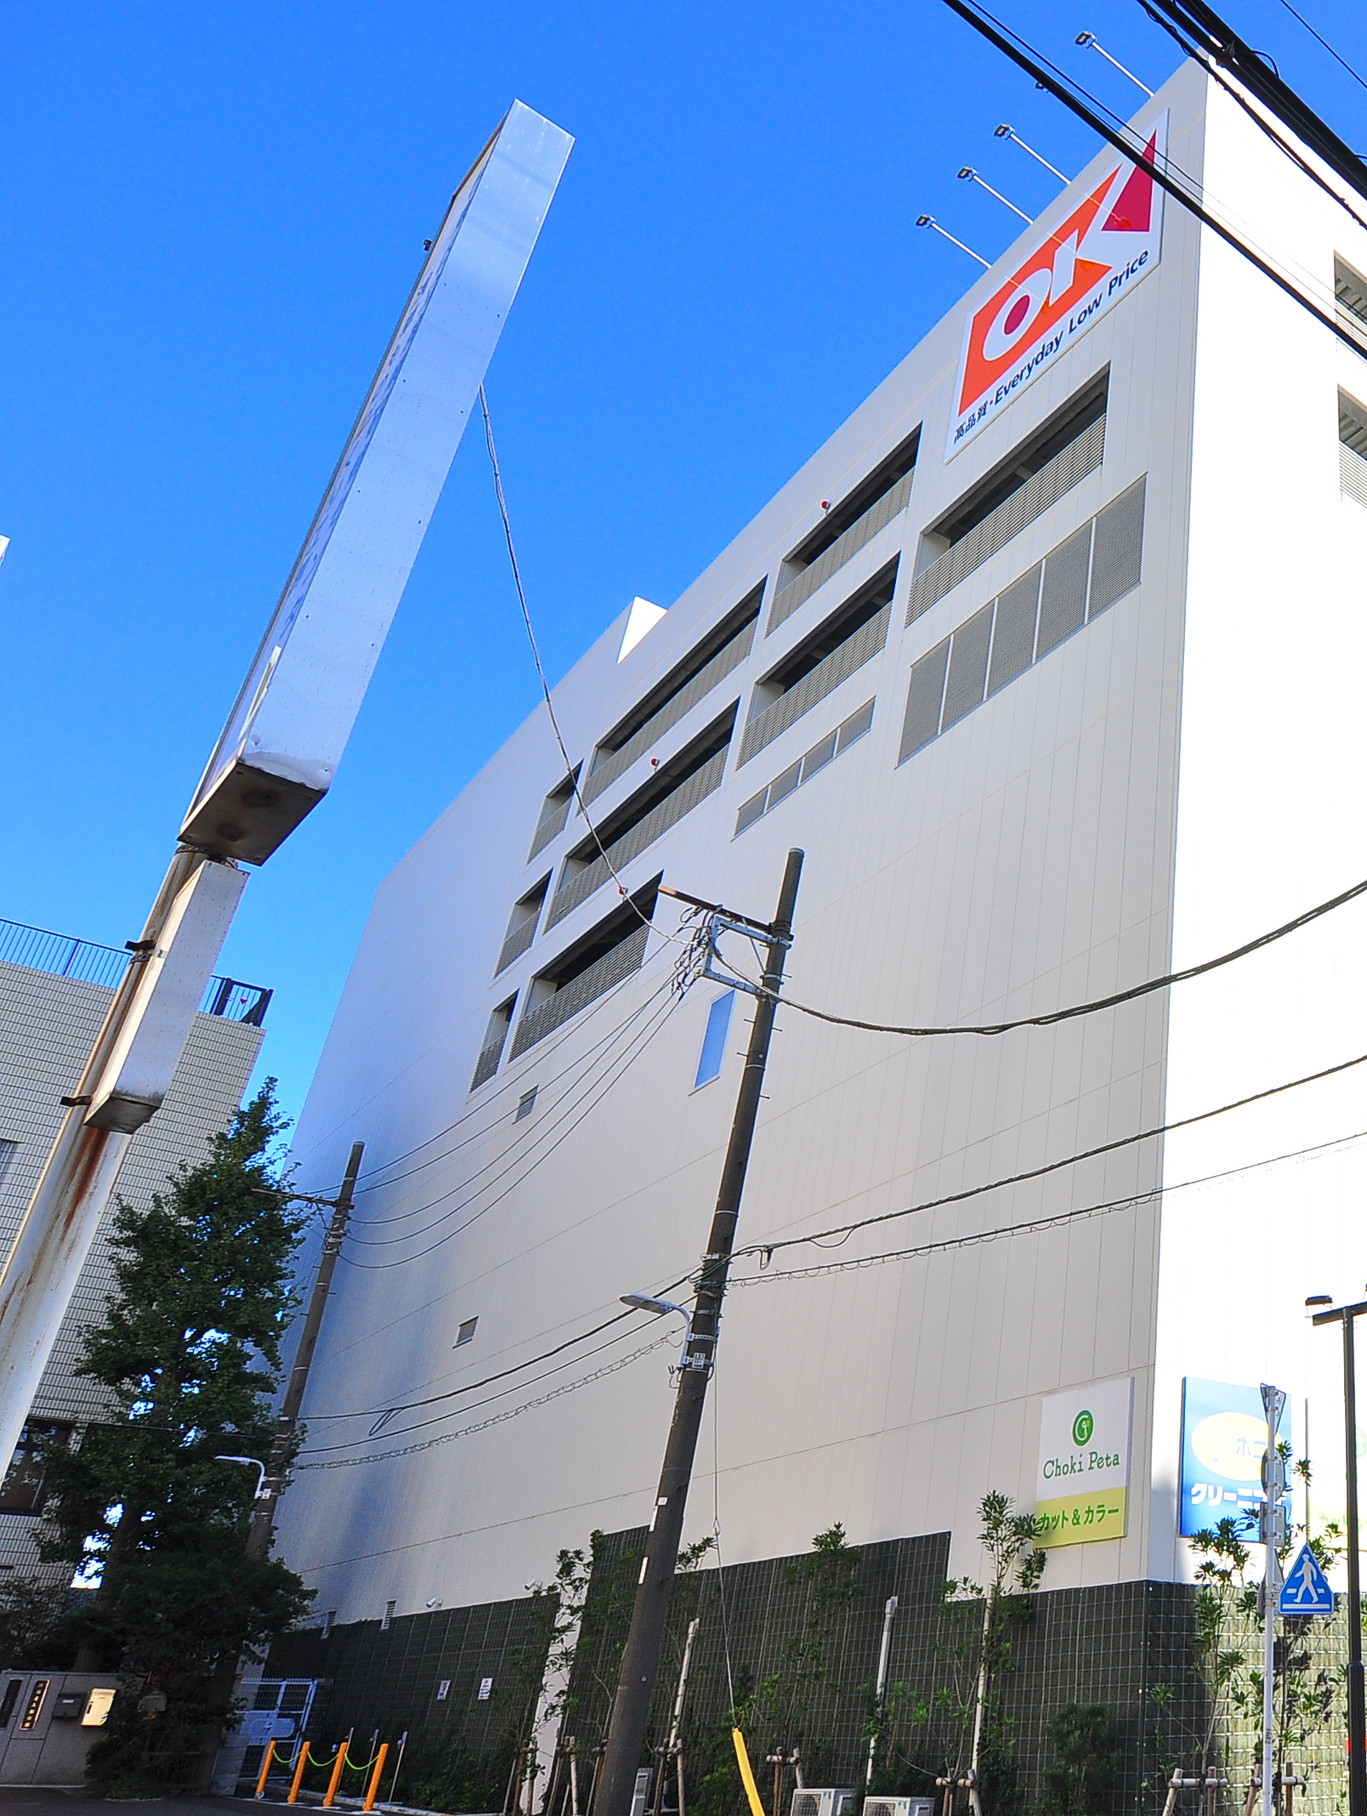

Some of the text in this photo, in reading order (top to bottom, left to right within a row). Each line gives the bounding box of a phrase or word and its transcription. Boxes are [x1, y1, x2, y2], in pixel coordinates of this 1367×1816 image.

[980, 130, 1156, 362] OK
[1068, 293, 1103, 335] Low
[1108, 249, 1149, 297] Price
[1042, 1451, 1120, 1479] Choki Peta
